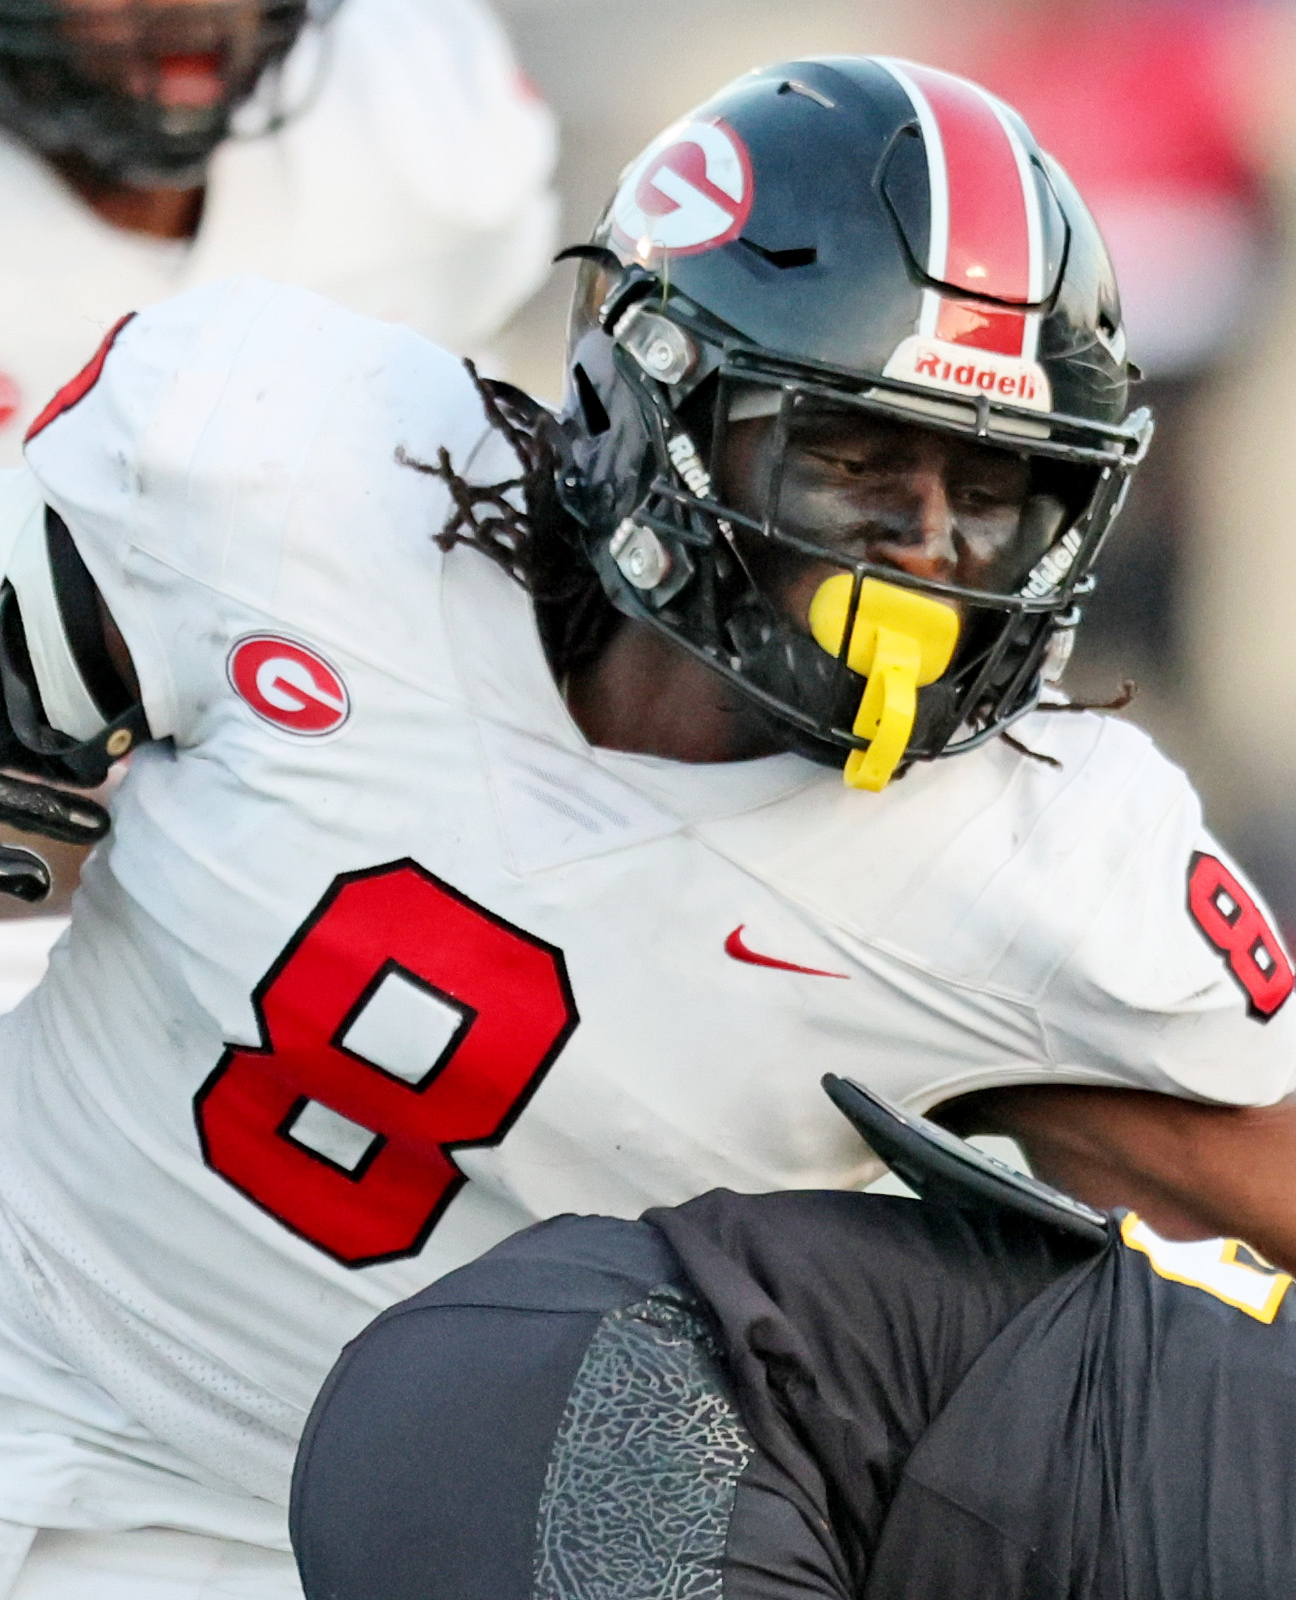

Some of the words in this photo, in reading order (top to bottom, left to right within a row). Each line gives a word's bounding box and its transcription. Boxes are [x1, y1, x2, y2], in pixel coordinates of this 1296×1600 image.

[613, 121, 745, 249] G
[914, 348, 1038, 400] Riddell
[232, 639, 345, 731] G
[1185, 849, 1294, 1026] 8
[192, 856, 581, 1270] 8
